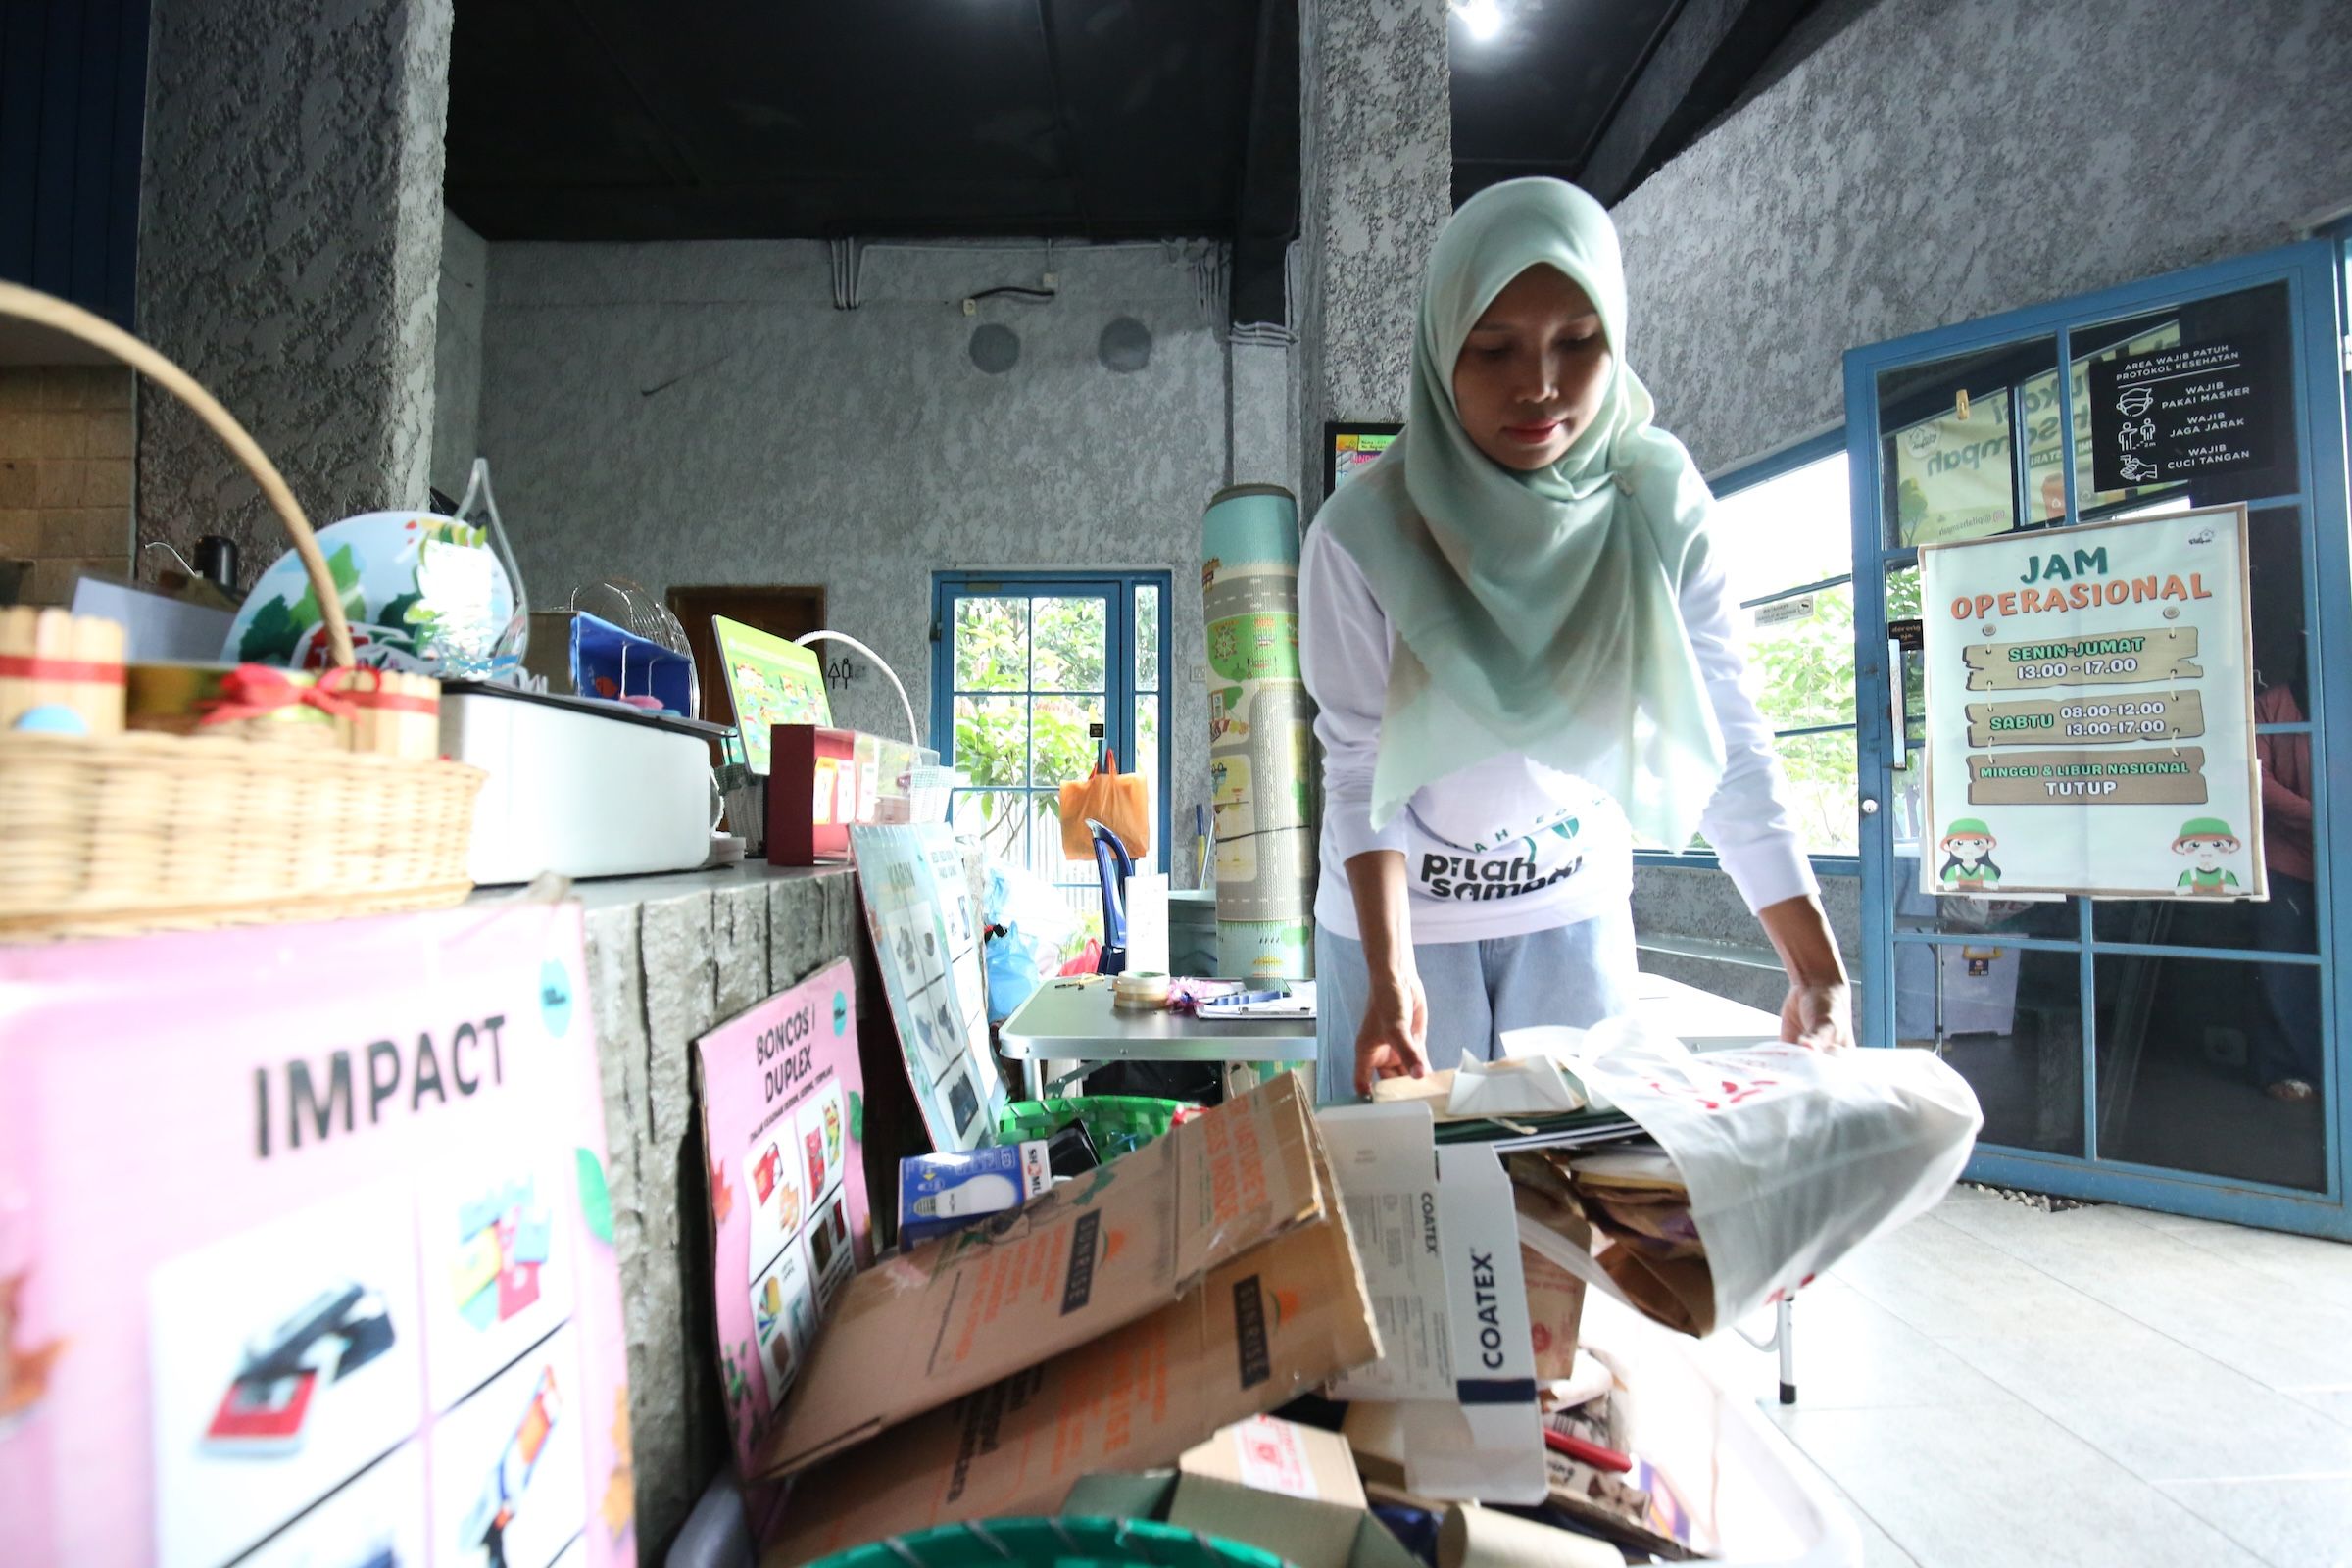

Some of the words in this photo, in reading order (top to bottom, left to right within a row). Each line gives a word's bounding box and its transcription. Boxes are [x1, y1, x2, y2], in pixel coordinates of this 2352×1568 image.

[2117, 367, 2172, 381] PROTOKOL
[2176, 352, 2239, 369] KESEHATAN
[2125, 360, 2152, 370] AREA
[2156, 353, 2189, 365] WAJIB
[2193, 345, 2229, 357] PATUH
[2162, 394, 2196, 409] PAKAI
[2201, 387, 2250, 402] MASKER
[2185, 381, 2224, 394] WAJIB
[2170, 425, 2200, 437] JAGA
[2205, 418, 2244, 432] JARAK
[2187, 412, 2225, 425] WAJIB
[2168, 459, 2195, 469] CUCI
[2200, 451, 2250, 465] TANGAN
[2188, 444, 2227, 457] WAJIB
[2020, 545, 2109, 584] JAM
[1950, 572, 2212, 619] OPERASIONAL
[2008, 636, 2146, 662] SENIN-JUMAT
[2017, 662, 2068, 681] 13.00
[2083, 658, 2138, 676] 17.00
[1989, 712, 2055, 731] SABTU
[2059, 700, 2166, 720] 08.00-12.00
[2065, 719, 2166, 738] 13.00-17.00
[1980, 765, 2040, 779] MINGGU
[2042, 765, 2054, 777] &
[2057, 763, 2103, 777] LIBUR
[2107, 761, 2189, 775] NASIONAL
[2045, 780, 2118, 796] TUTUP
[1421, 853, 1537, 882] pilah
[756, 1005, 809, 1066] BONCOS
[254, 1015, 506, 1157] IMPACT
[764, 1045, 813, 1104] DUPLEX
[1421, 1191, 1439, 1255] COATEX
[1066, 1218, 1096, 1306] SUNRISE
[1470, 1252, 1504, 1370] COATEX
[1239, 1286, 1267, 1377] SUNRISE
